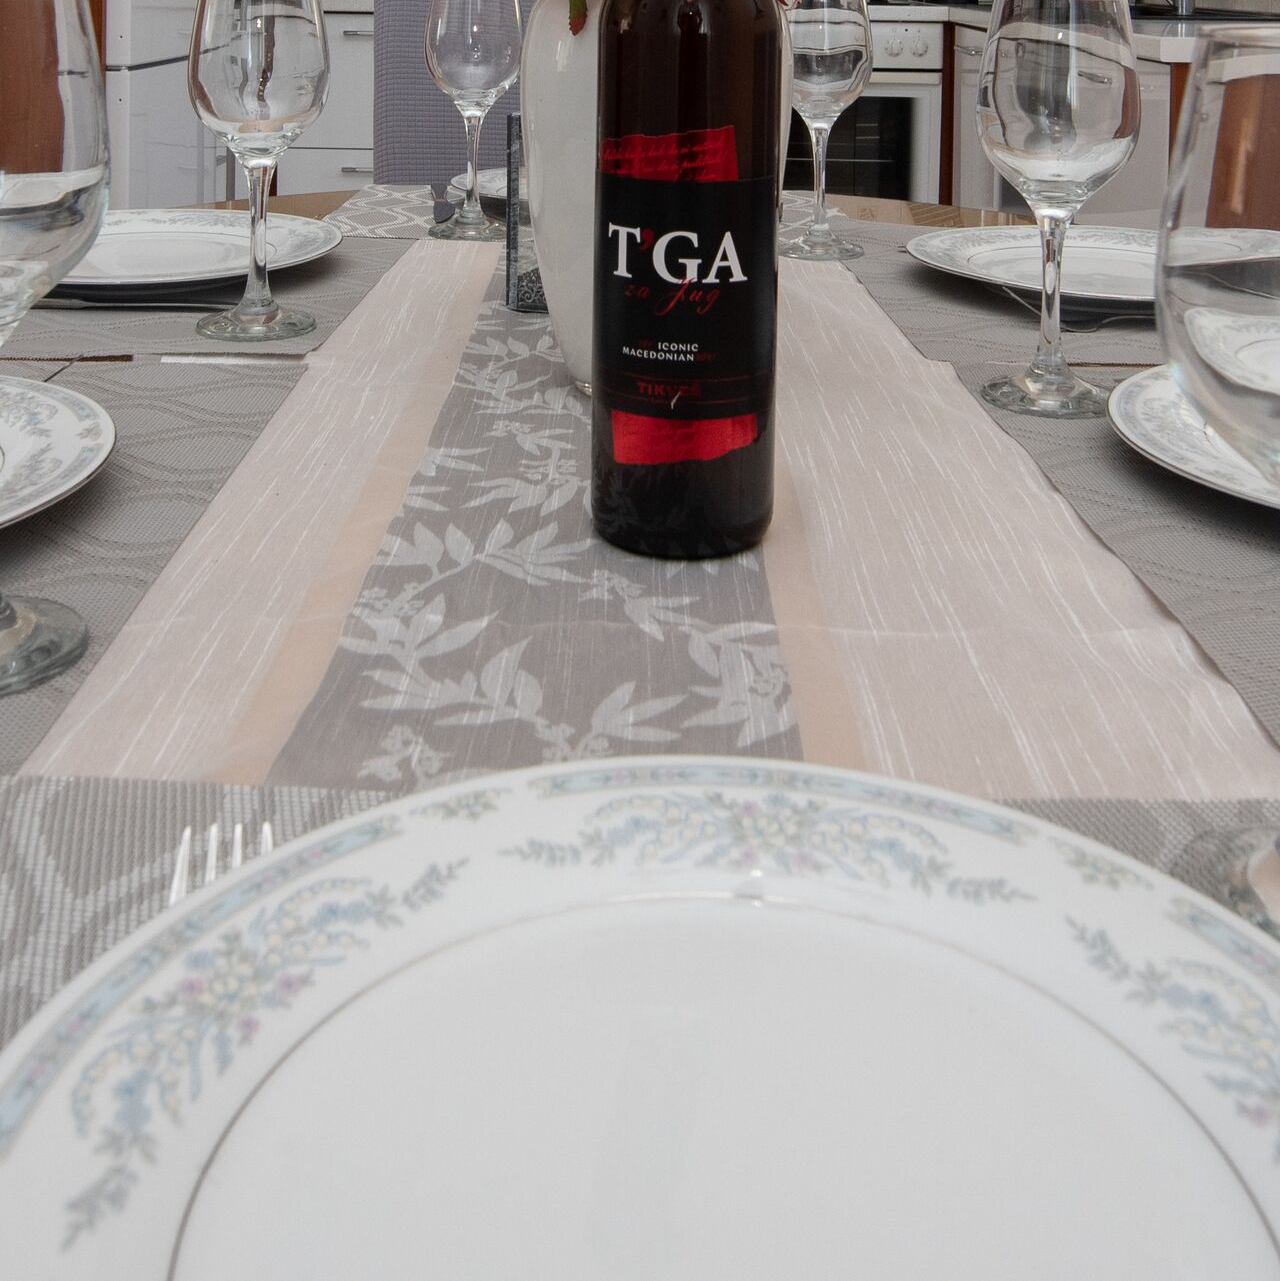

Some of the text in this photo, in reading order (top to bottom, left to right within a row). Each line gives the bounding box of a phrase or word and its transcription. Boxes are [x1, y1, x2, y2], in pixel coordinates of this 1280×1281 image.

[608, 221, 748, 285] T'GA
[624, 277, 720, 316] za Jug
[622, 346, 695, 362] MACEDONIAN
[658, 342, 699, 352] ICONIC
